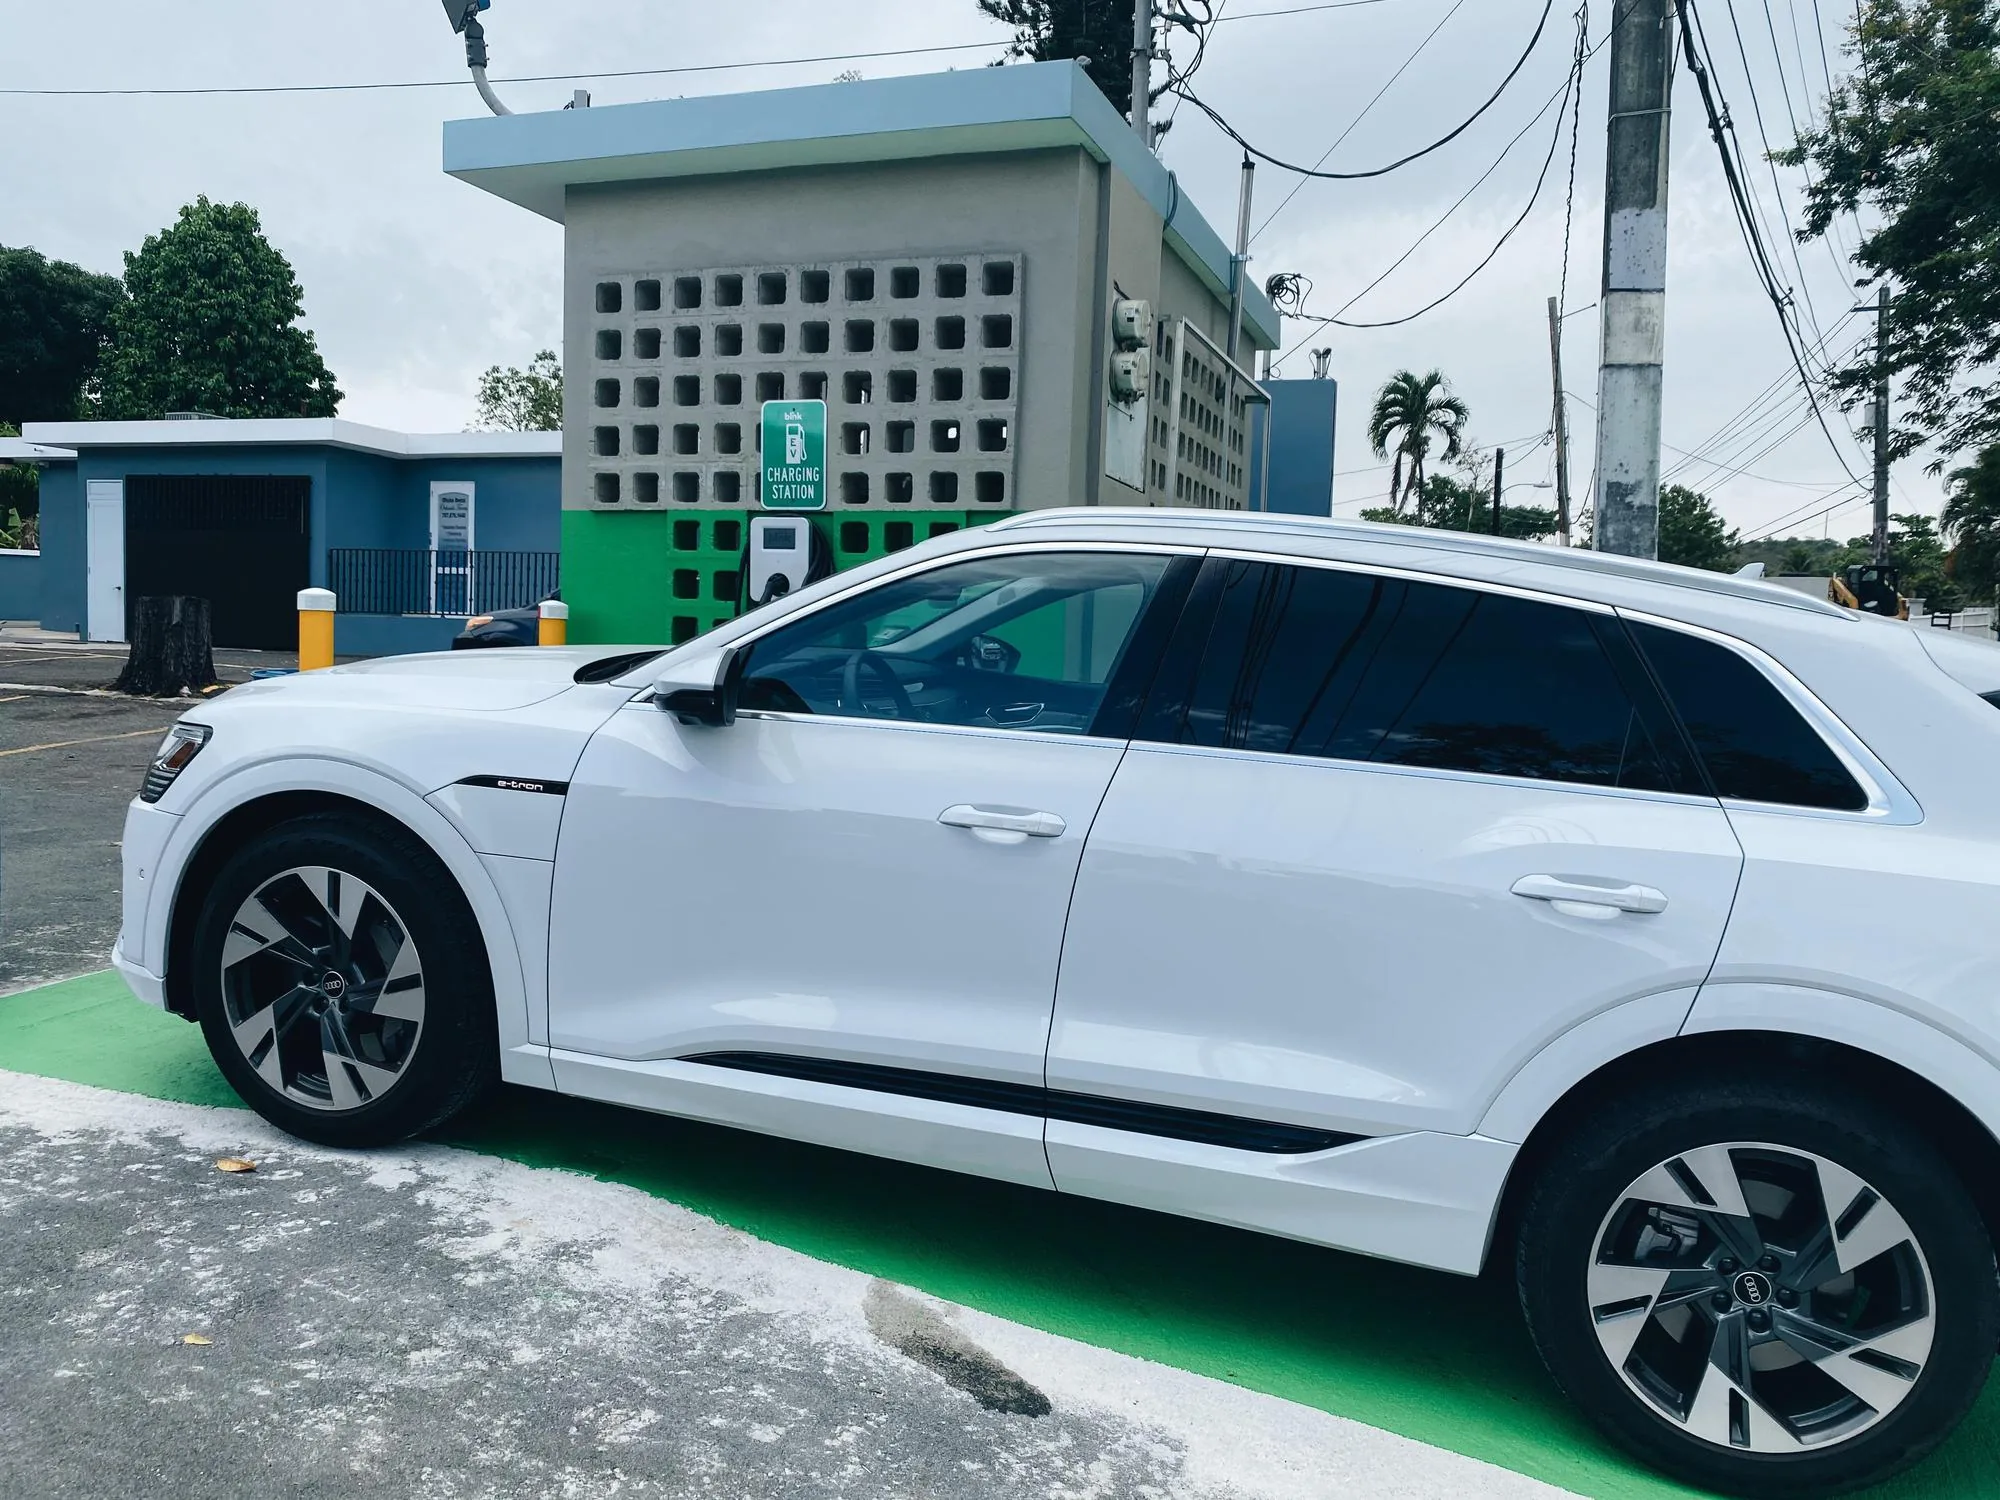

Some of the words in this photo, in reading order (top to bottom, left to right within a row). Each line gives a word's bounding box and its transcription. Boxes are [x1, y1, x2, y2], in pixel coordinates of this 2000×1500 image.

[784, 411, 802, 421] blink
[767, 467, 820, 482] CHARGING
[772, 484, 815, 499] STATION
[498, 780, 543, 792] e-tron
